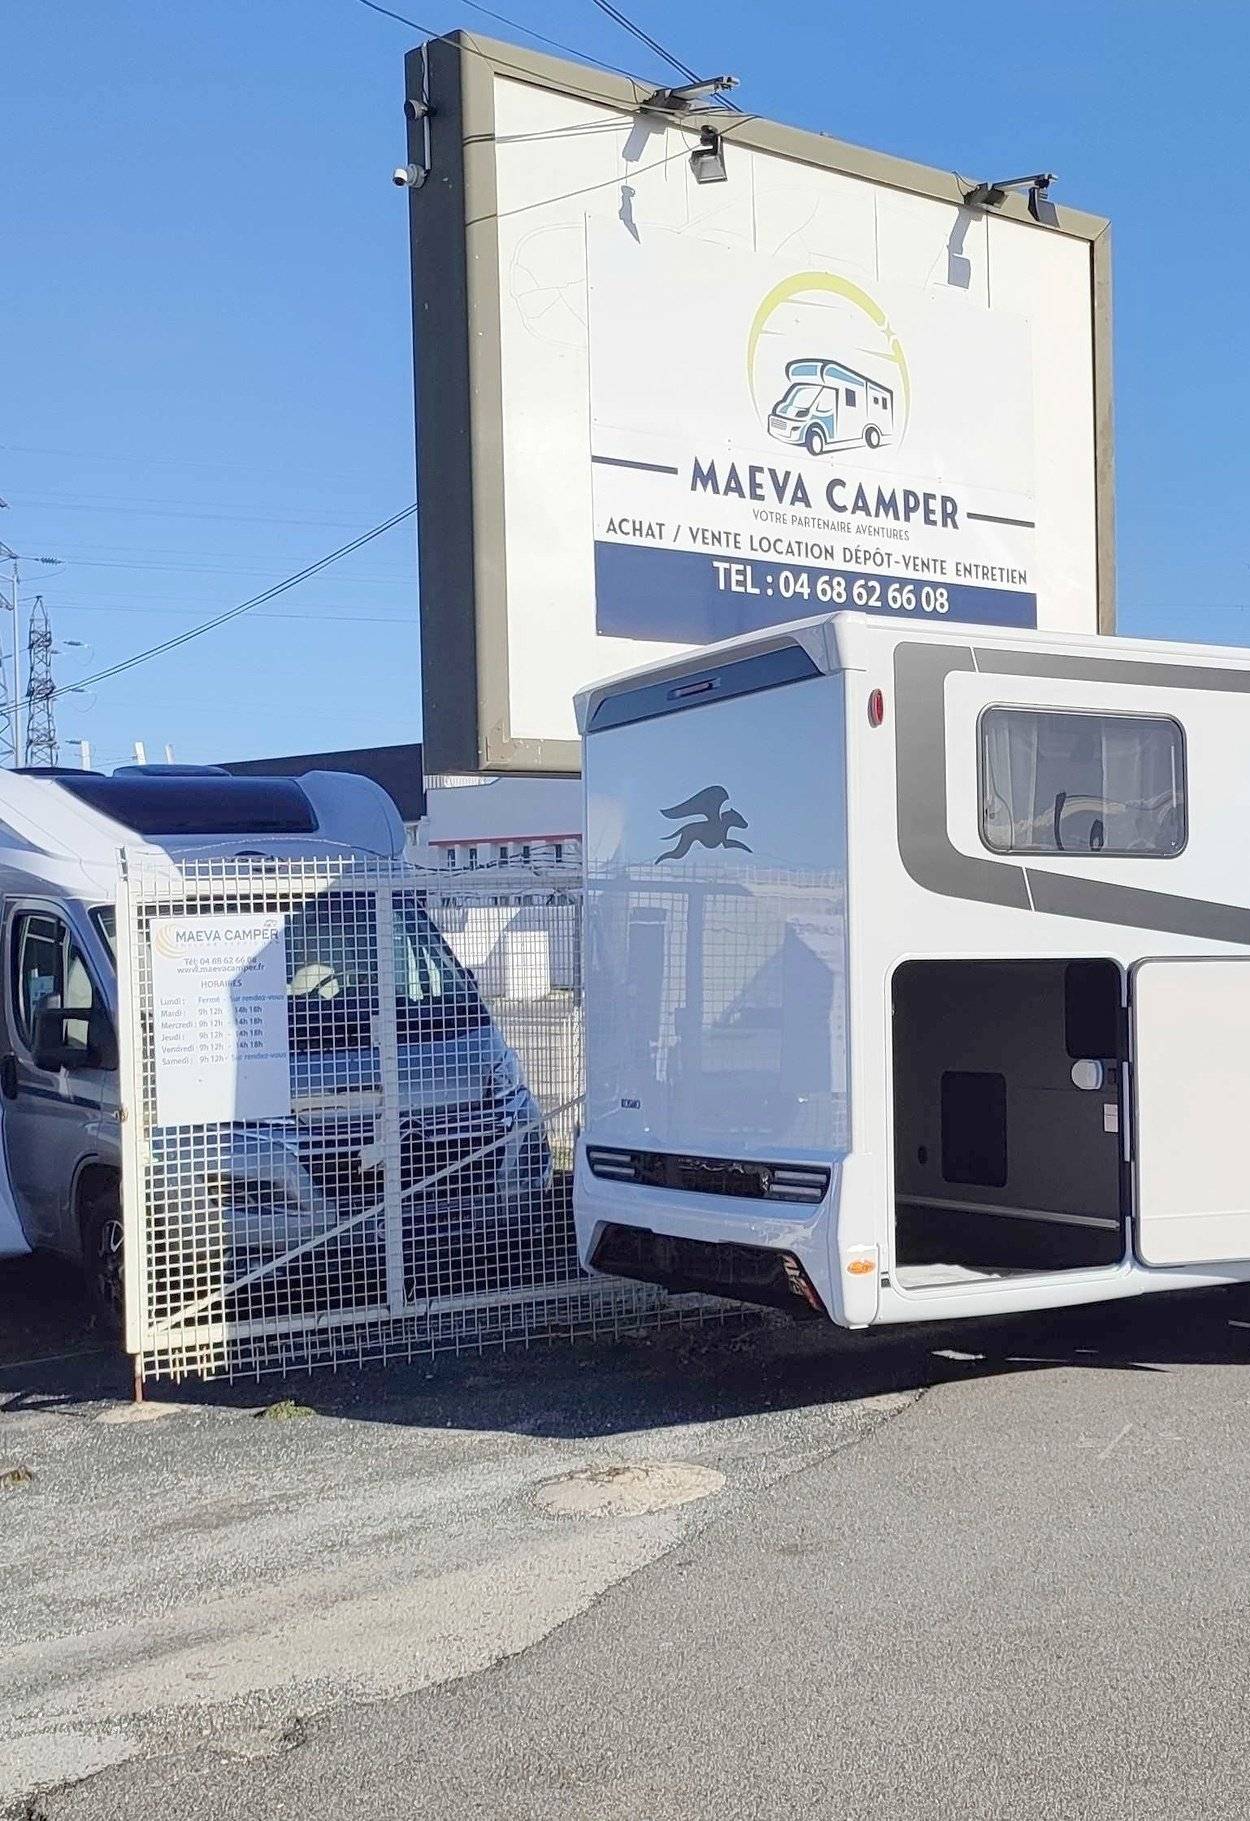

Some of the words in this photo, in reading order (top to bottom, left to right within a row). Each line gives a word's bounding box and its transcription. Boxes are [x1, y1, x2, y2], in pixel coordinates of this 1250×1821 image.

[691, 456, 812, 508] MAEVA
[825, 478, 960, 530] CAMPER
[752, 508, 788, 525] VOTRE
[791, 514, 851, 534] PARTENAIRE
[855, 523, 910, 542] AVENTURES
[605, 517, 666, 540] ACHAT
[673, 524, 681, 543] /
[688, 526, 742, 550] VENTE
[749, 534, 835, 560] LOCATION
[843, 544, 947, 576] DÉPÔT-VENTE
[955, 561, 1028, 585] ENTRETIEN
[778, 570, 811, 600] 04
[816, 575, 848, 604] 68
[852, 579, 882, 608] 62
[887, 582, 917, 612] 66
[921, 585, 950, 614] 08
[176, 929, 222, 942] MAEVA
[224, 928, 279, 941] CAMPER
